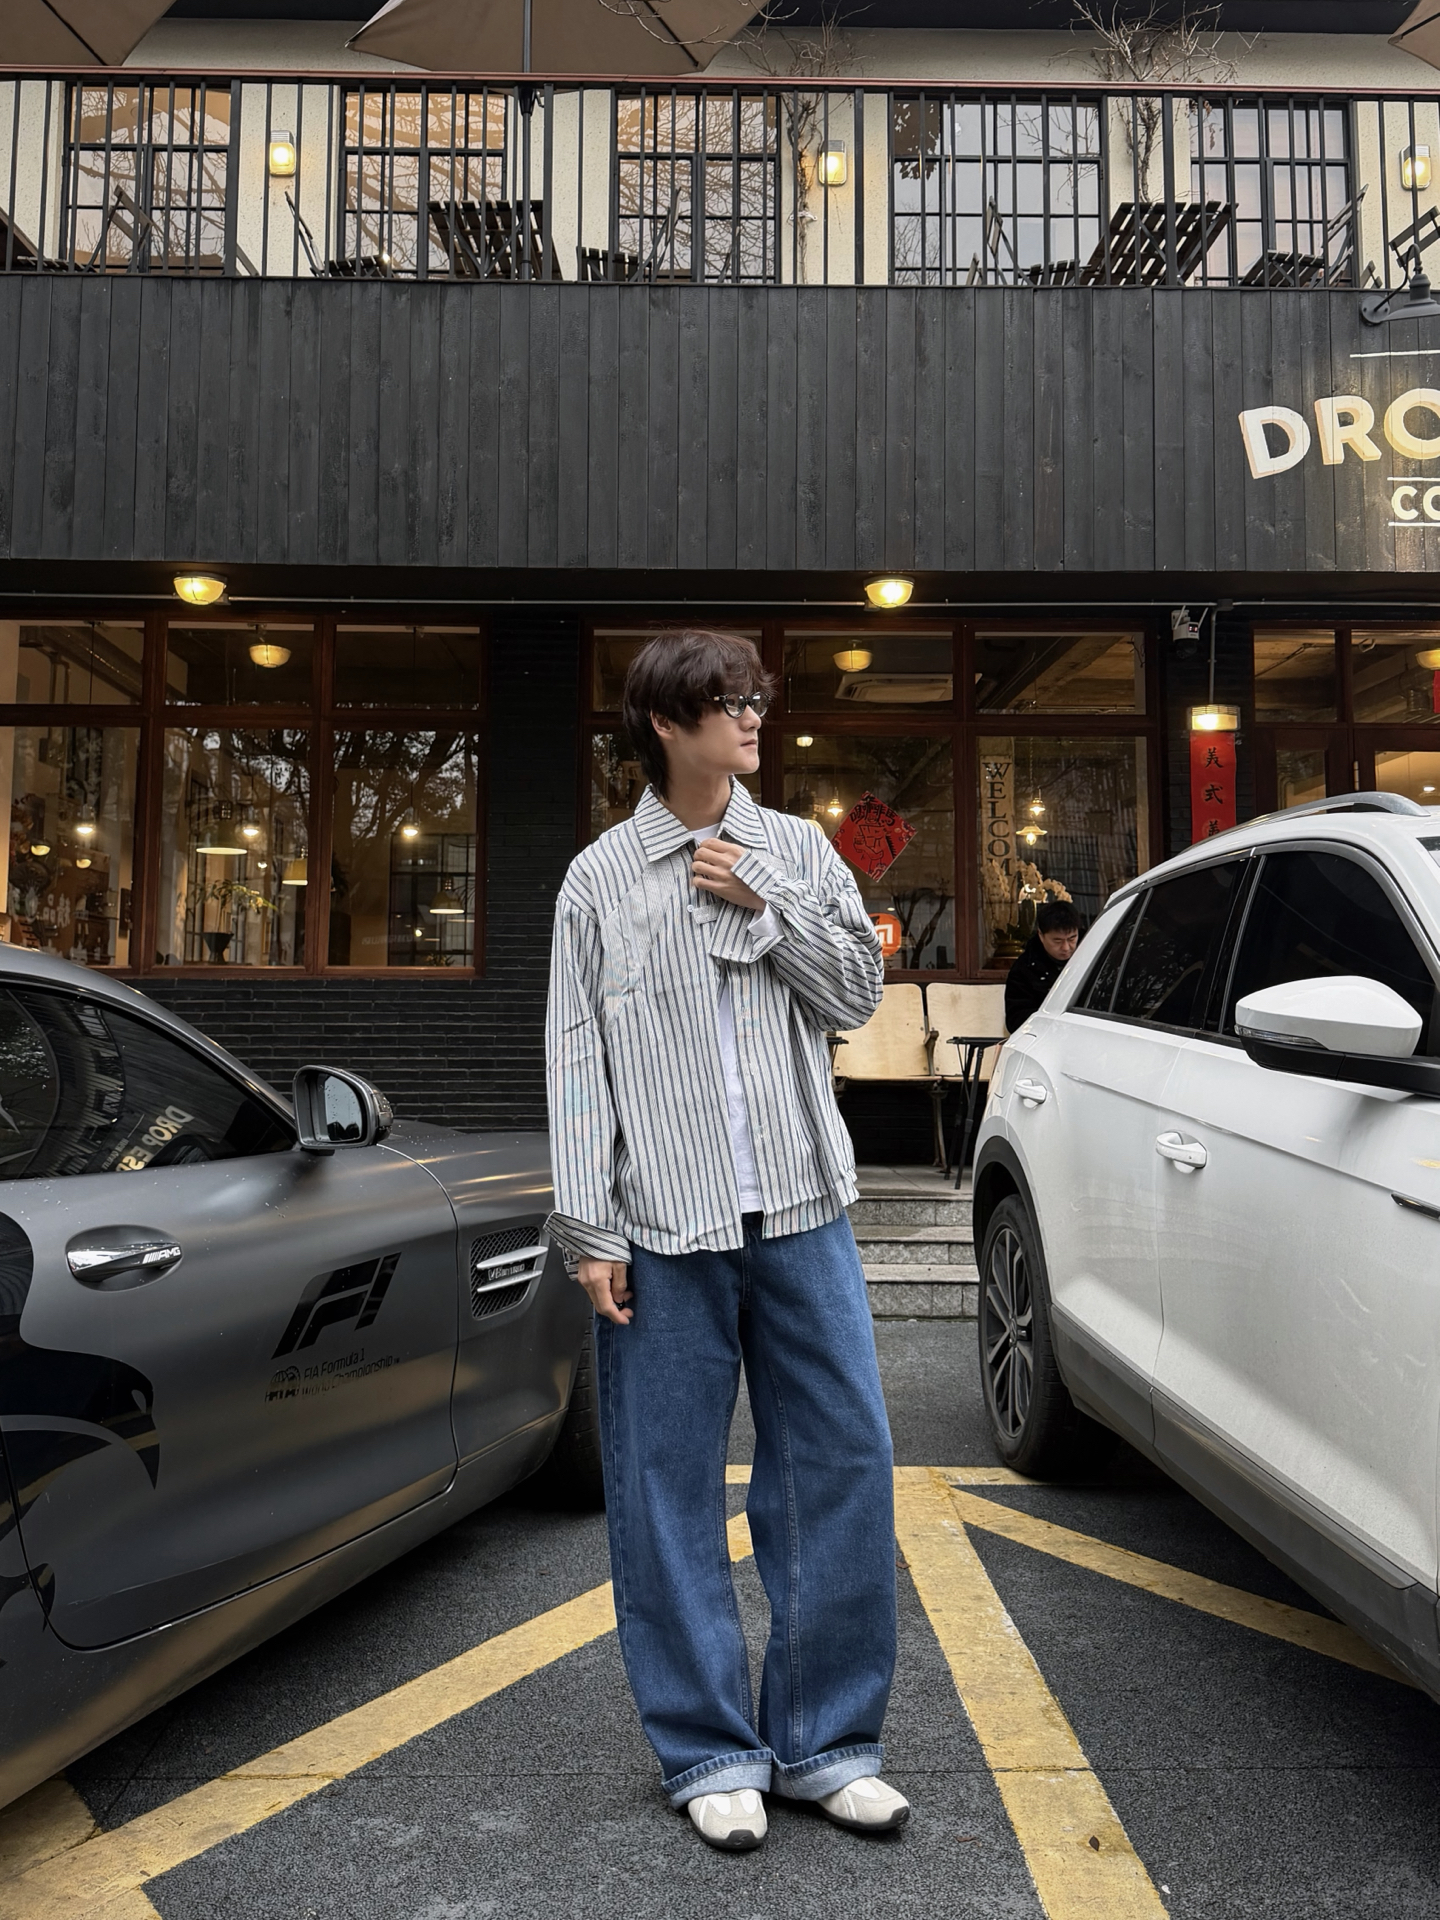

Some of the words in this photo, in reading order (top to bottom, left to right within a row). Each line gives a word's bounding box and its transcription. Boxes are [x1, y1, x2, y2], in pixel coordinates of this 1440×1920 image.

[1238, 387, 1440, 480] DRO
[304, 1365, 319, 1380] FIA
[320, 1351, 360, 1377] Formula
